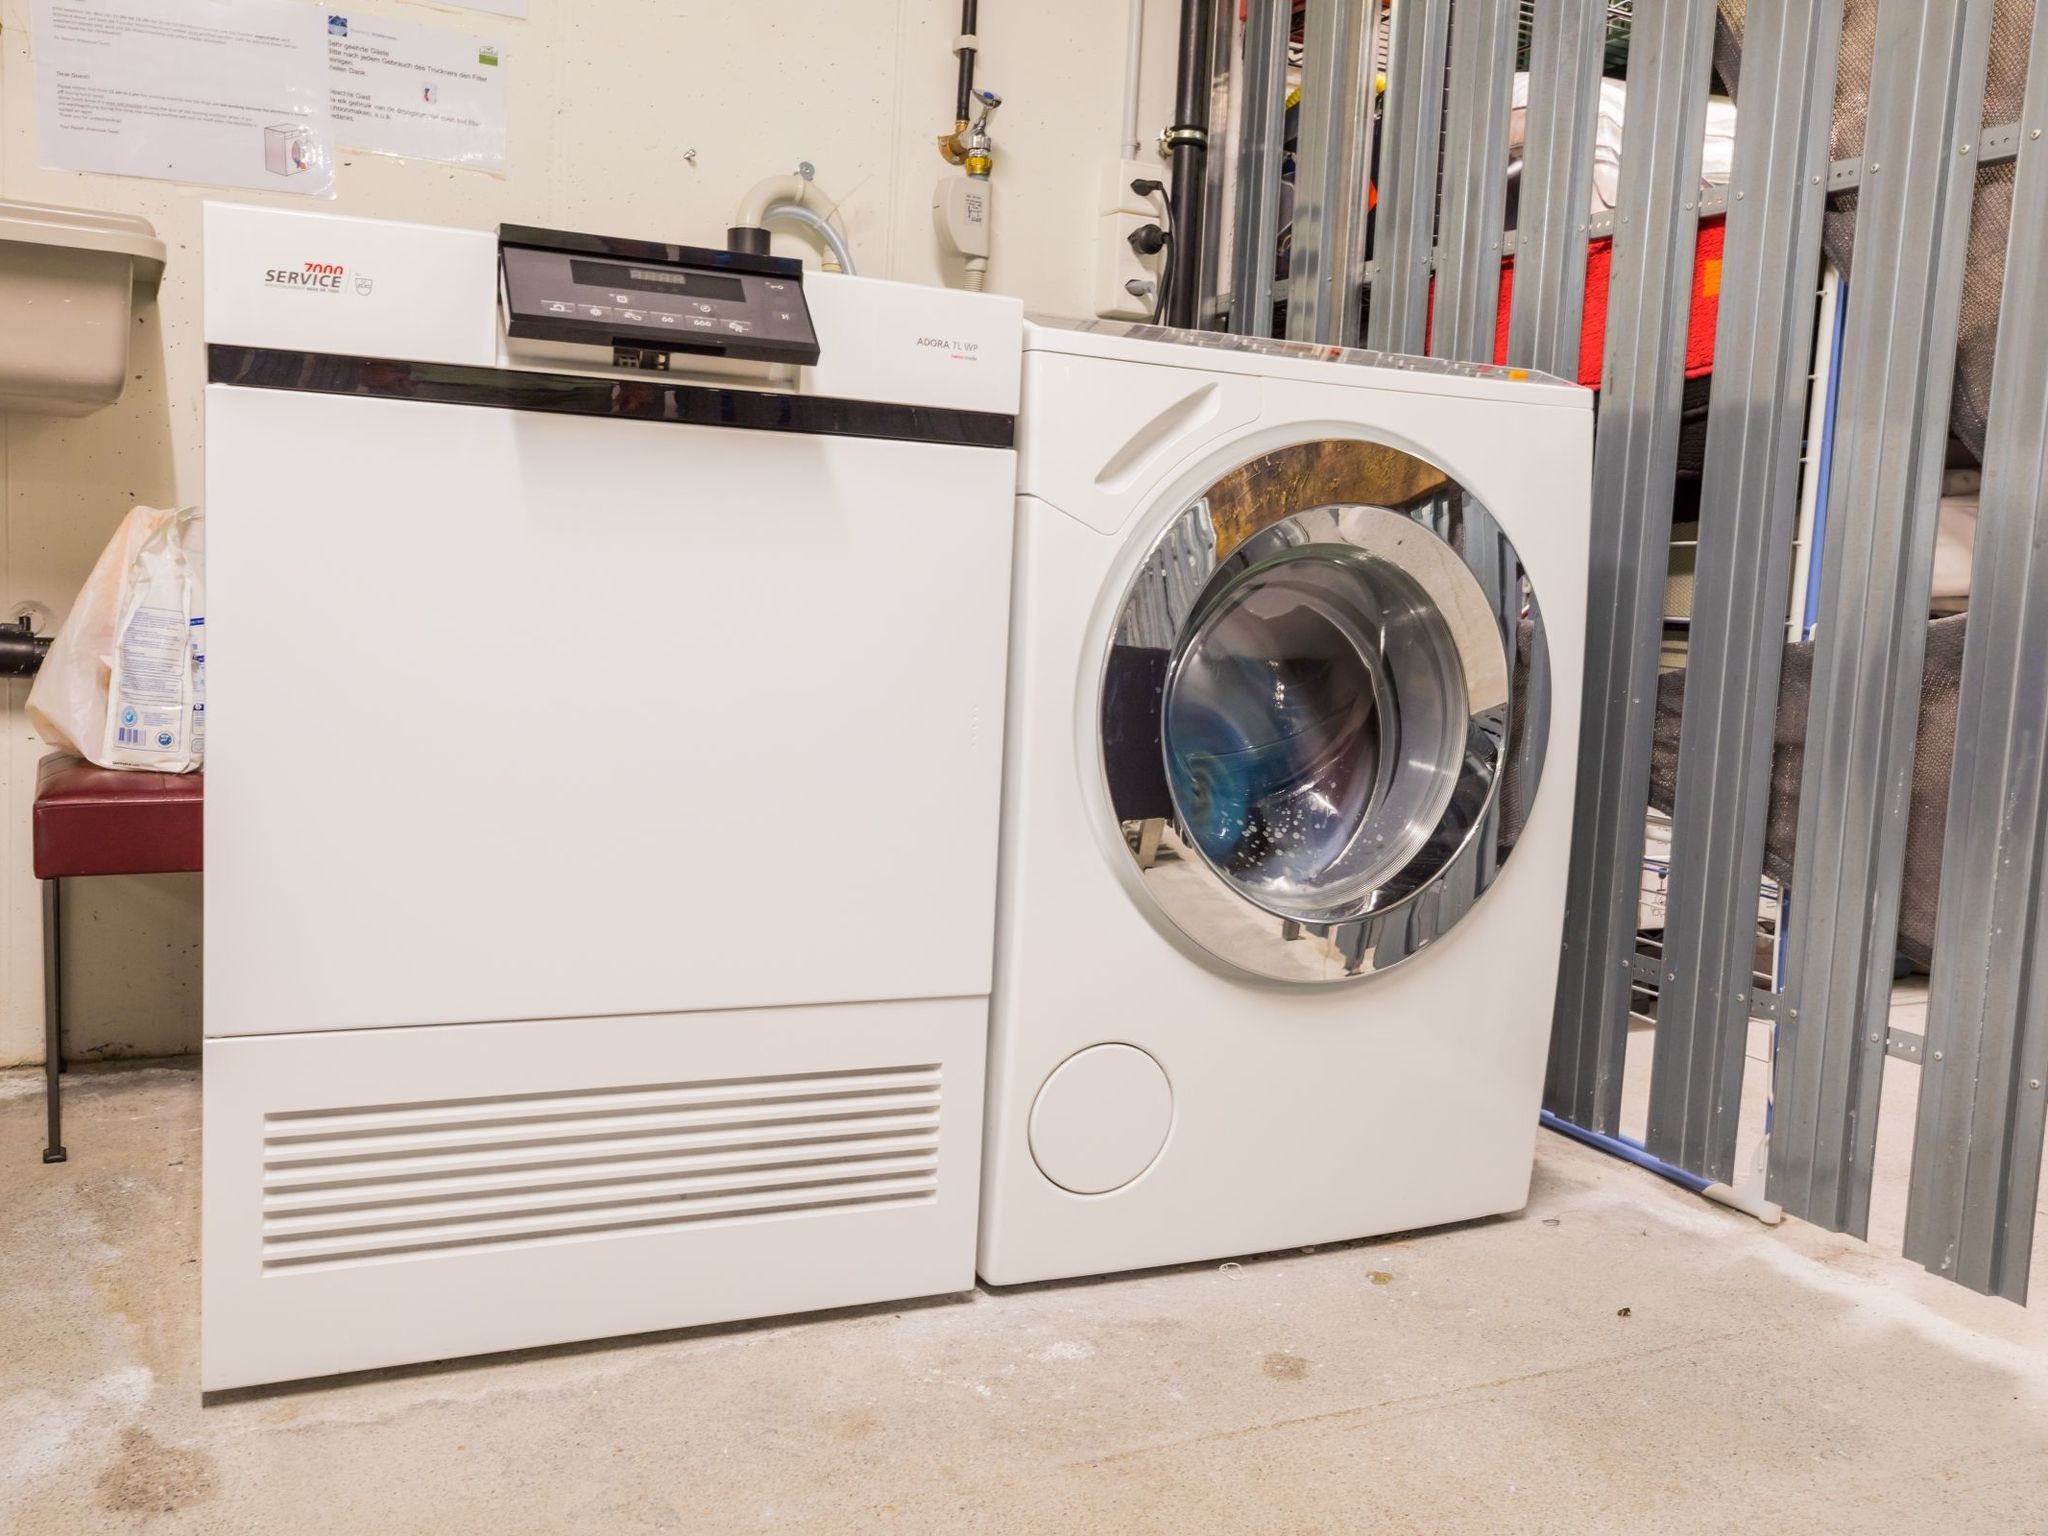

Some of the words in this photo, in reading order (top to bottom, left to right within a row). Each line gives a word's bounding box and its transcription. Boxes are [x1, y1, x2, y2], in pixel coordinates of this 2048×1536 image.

[304, 262, 344, 276] 7000
[264, 268, 342, 289] SERVICE
[917, 337, 950, 349] ADORA
[952, 341, 963, 351] TL
[964, 343, 979, 352] WP
